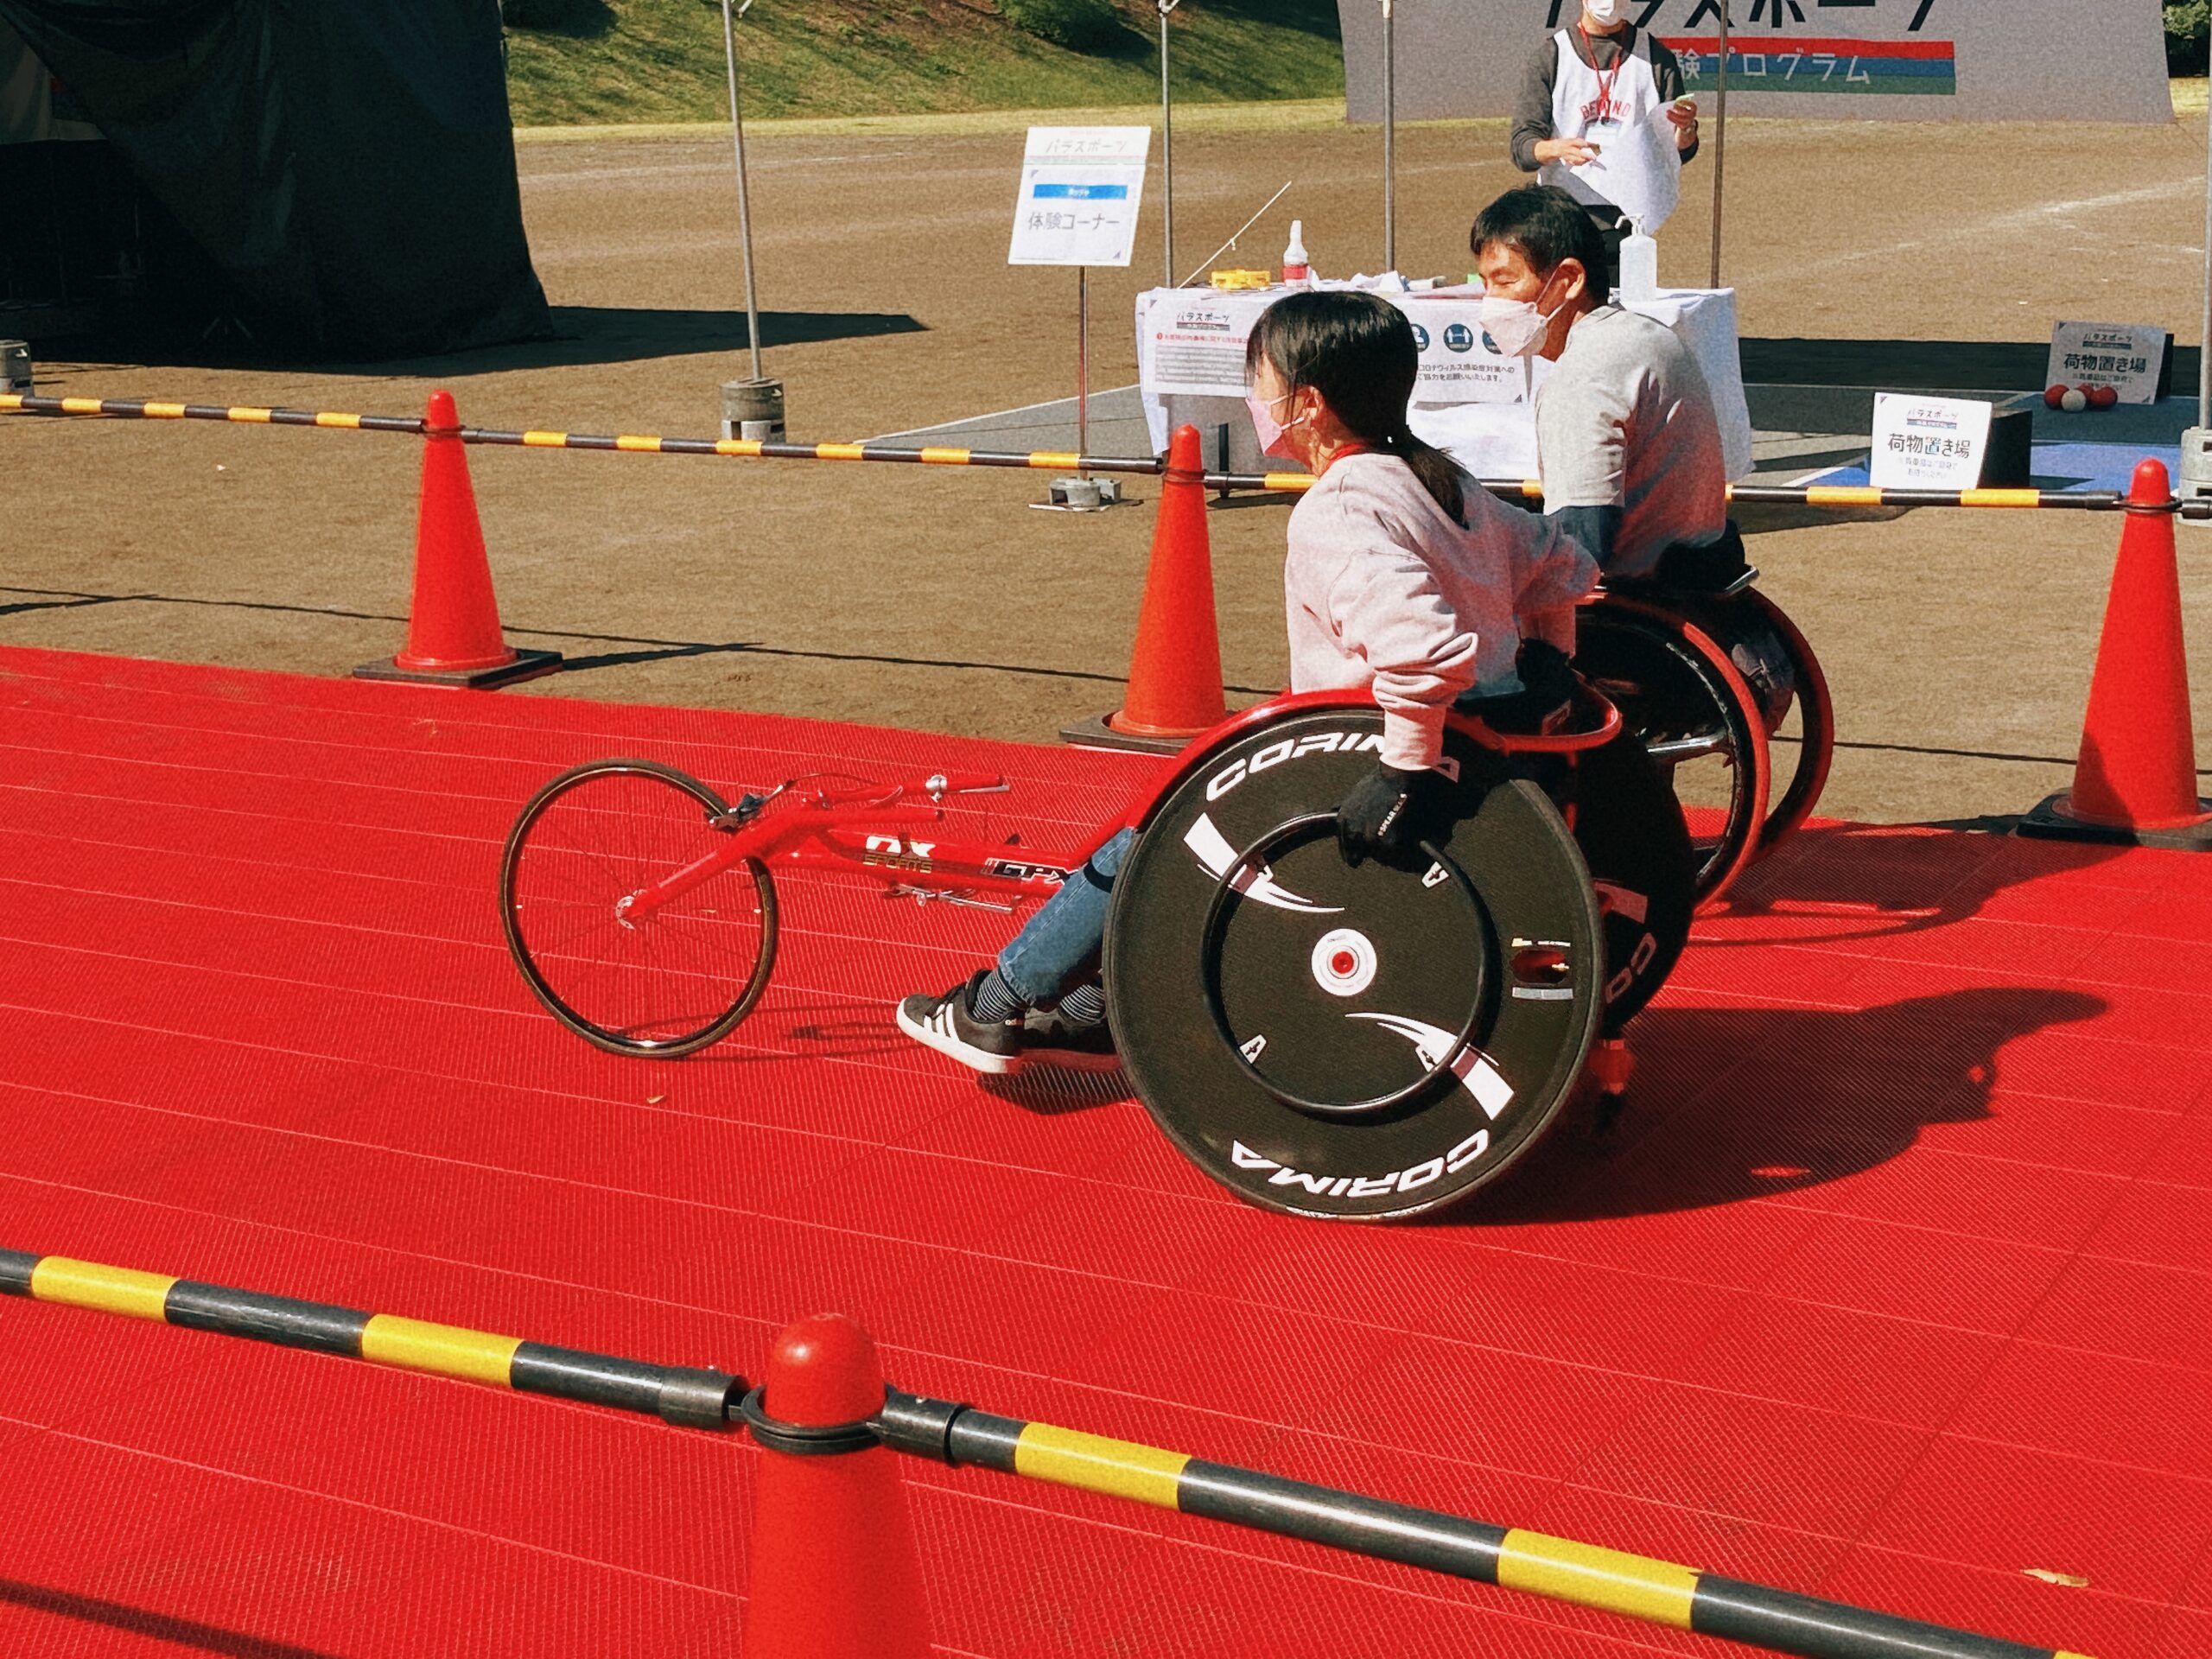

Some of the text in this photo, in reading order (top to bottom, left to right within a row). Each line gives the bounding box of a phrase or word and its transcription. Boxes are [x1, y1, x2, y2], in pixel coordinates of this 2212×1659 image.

[1671, 47, 1870, 84] 験プログラム
[1046, 138, 1128, 153] パラスポーツ
[1028, 213, 1121, 231] 体験コーナー
[1176, 312, 1230, 323] パラスポーツ
[2063, 353, 2147, 373] 荷物置き場
[1887, 433, 1971, 459] 荷物置き場
[862, 853, 933, 874] SPORTS
[1230, 1128, 1489, 1198] CORIMA
